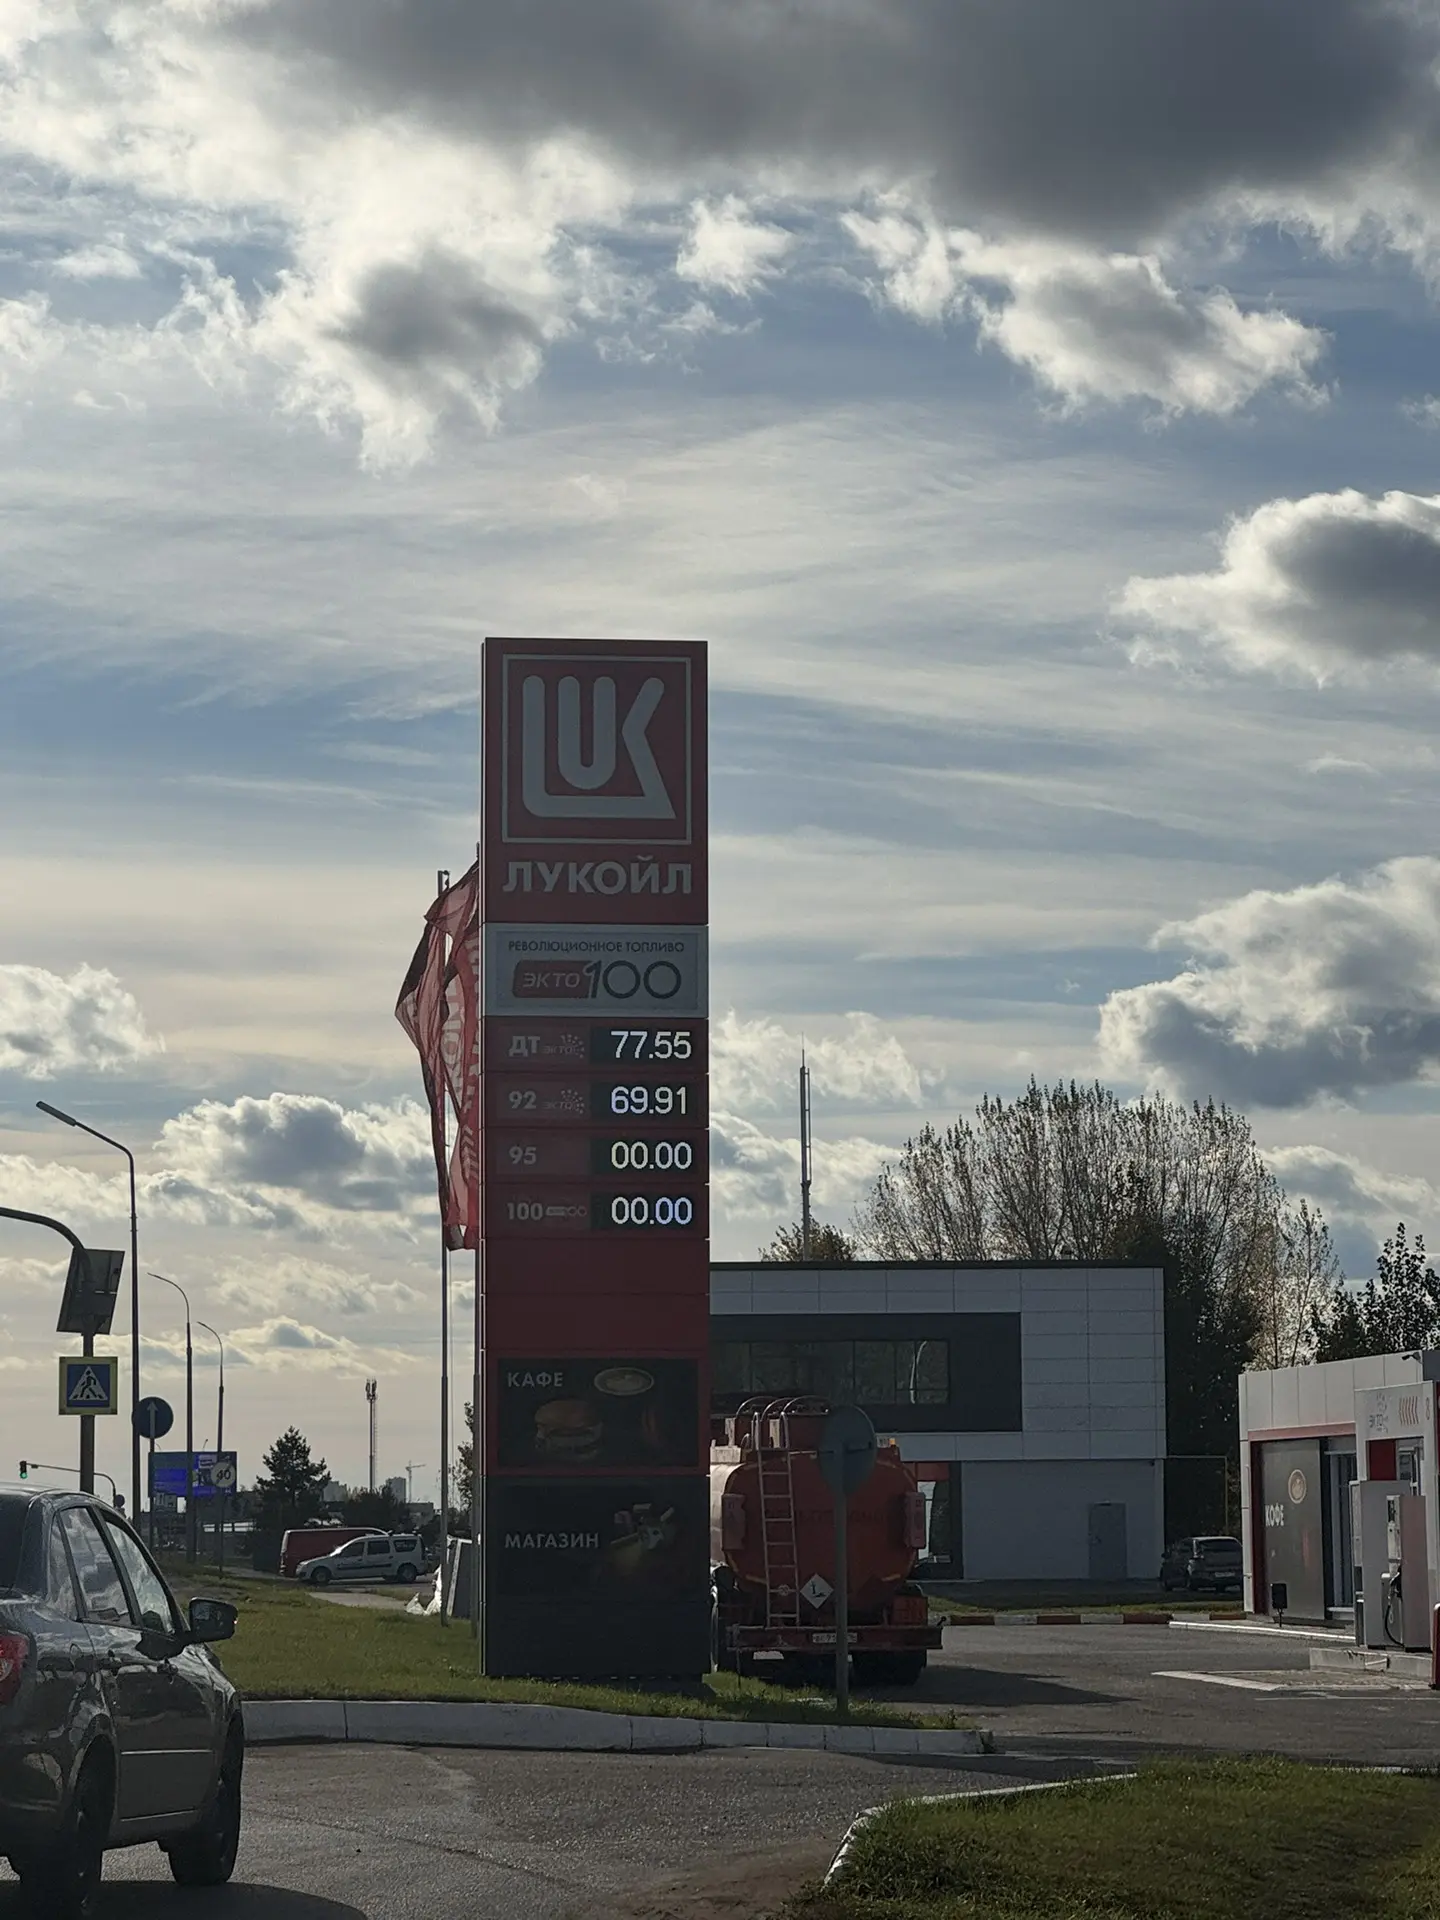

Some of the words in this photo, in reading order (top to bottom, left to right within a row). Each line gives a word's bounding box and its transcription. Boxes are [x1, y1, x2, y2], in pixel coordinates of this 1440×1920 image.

[503, 855, 692, 895] ЛУКОЙЛ
[508, 940, 622, 954] РЕВОЛЮЦИОННОЕ
[625, 941, 685, 953] ТОПЛИВО
[522, 972, 580, 988] ЭКТО
[584, 959, 682, 999] 100
[508, 1036, 541, 1058] ДТ
[610, 1030, 692, 1059] 77.55
[508, 1090, 537, 1110] 92
[611, 1086, 687, 1115] 69.91
[508, 1146, 537, 1165] 95
[611, 1141, 692, 1169] 00.00
[506, 1202, 543, 1220] 100
[611, 1196, 693, 1225] 00.00
[507, 1371, 564, 1387] КАФЕ
[216, 1469, 231, 1480] 40
[1264, 1504, 1285, 1528] КОФЕ
[504, 1532, 600, 1549] МАГАЗИН
